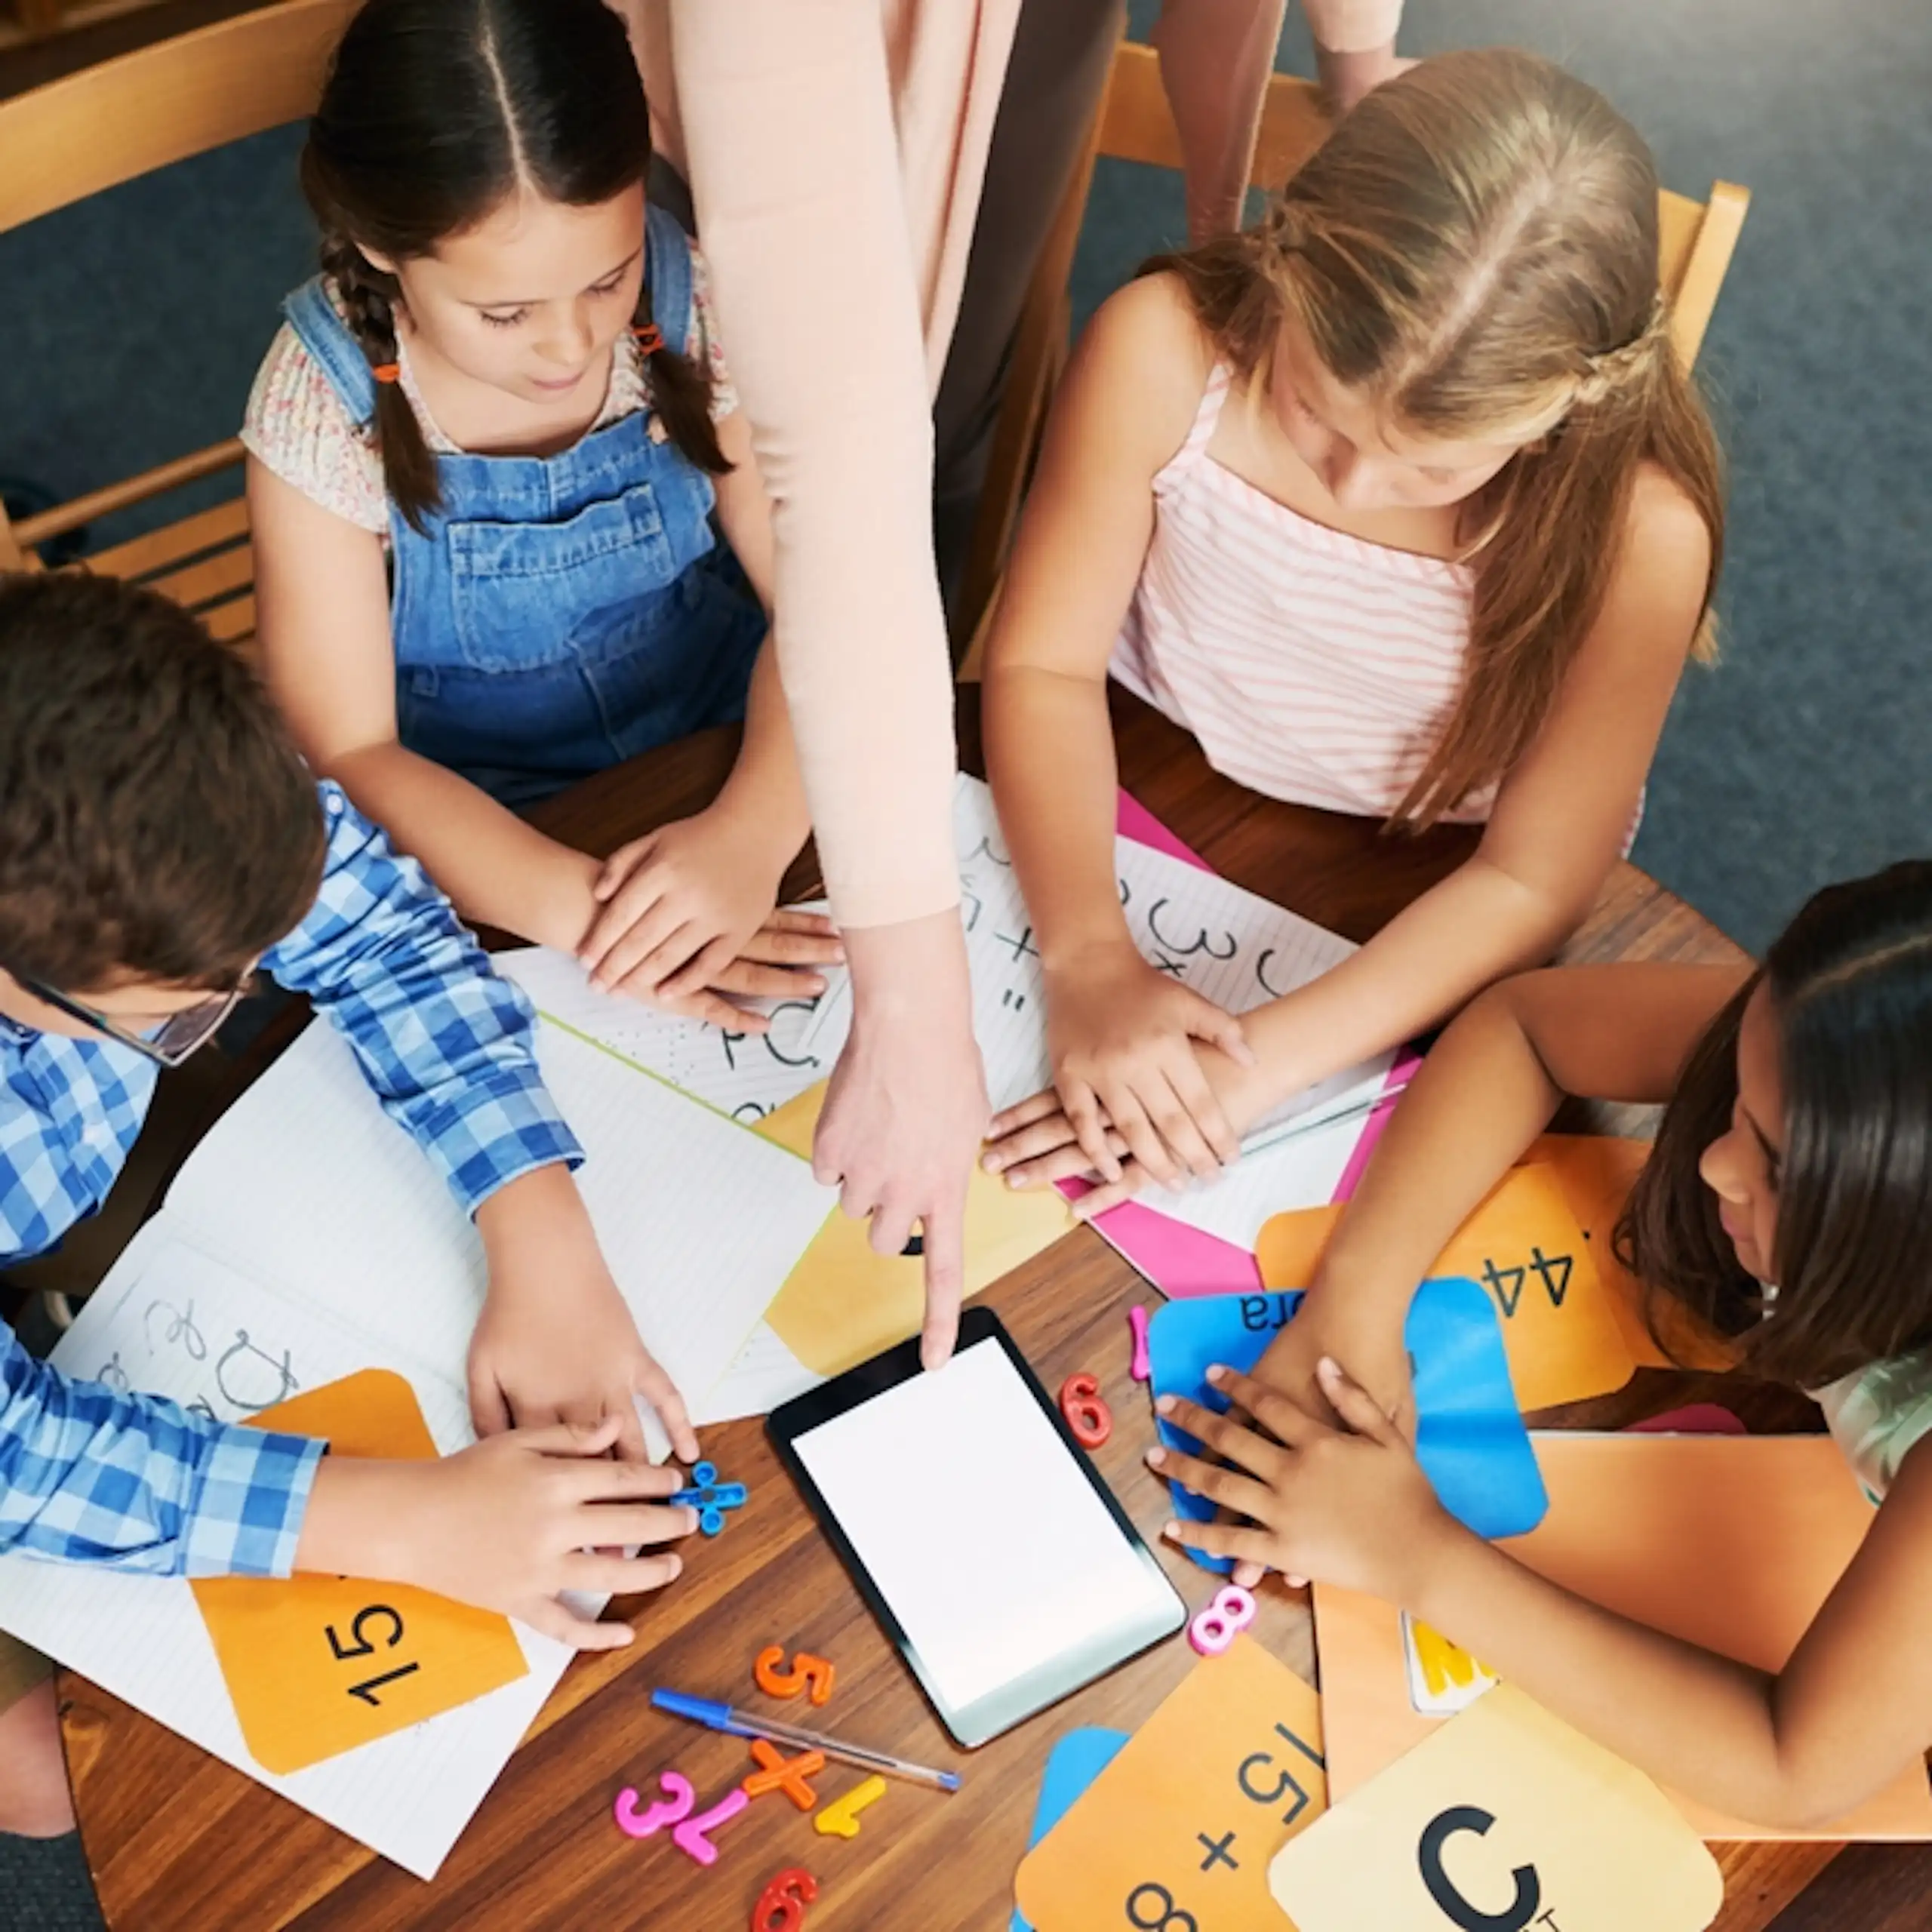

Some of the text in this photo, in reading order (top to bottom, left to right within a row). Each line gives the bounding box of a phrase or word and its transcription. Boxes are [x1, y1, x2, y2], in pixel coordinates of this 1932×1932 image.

[1481, 1247, 1574, 1318] 44
[325, 1603, 420, 1707] 15
[1187, 1584, 1257, 1656] 8
[755, 1644, 836, 1707] 5
[614, 1770, 695, 1838] 3
[813, 1774, 888, 1838] 1
[1237, 1721, 1327, 1826] 15
[672, 1788, 749, 1866] 7
[1417, 1804, 1541, 1932] C
[1125, 1881, 1198, 1932] 8
